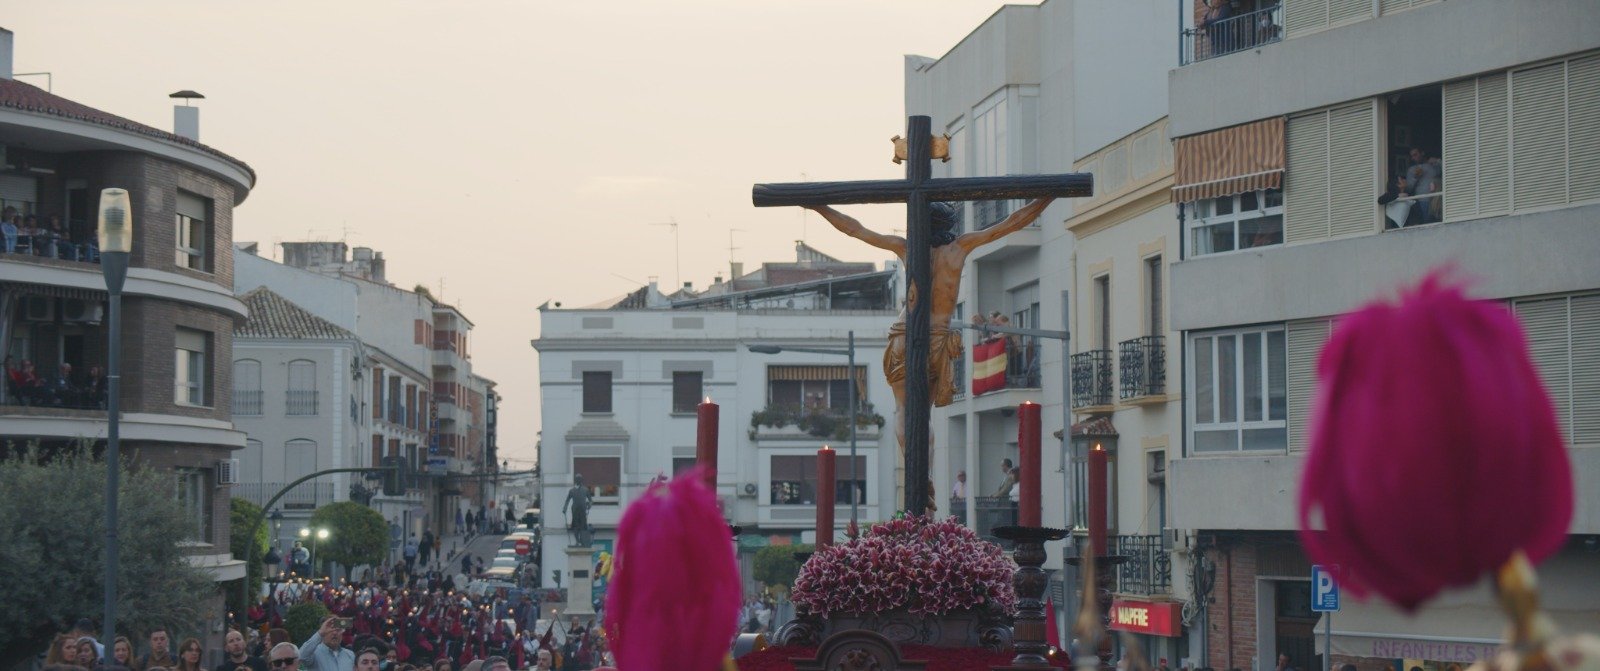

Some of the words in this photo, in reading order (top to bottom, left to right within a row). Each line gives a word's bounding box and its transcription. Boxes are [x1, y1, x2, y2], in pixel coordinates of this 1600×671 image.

[430, 402, 438, 444] HOTEL
[1317, 571, 1333, 605] P
[1117, 606, 1148, 627] MAPFRE
[1372, 640, 1477, 662] INFANTILES
